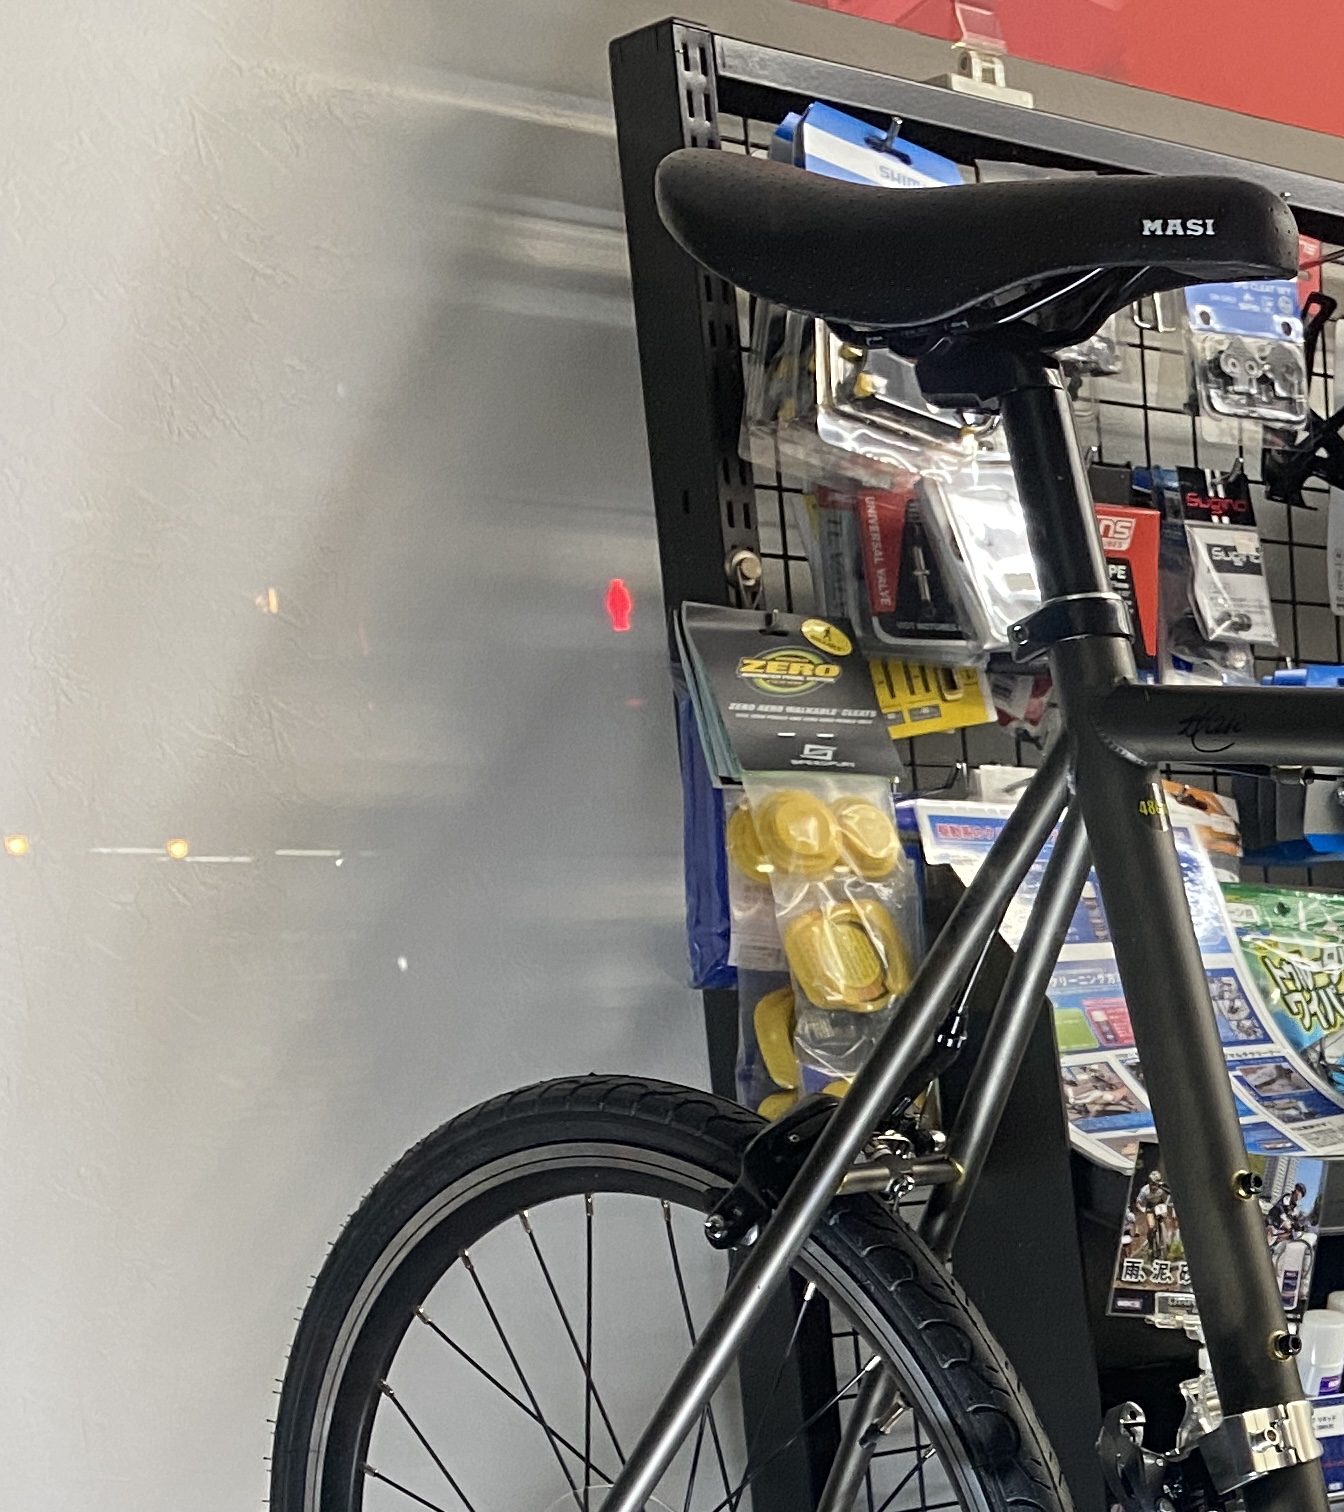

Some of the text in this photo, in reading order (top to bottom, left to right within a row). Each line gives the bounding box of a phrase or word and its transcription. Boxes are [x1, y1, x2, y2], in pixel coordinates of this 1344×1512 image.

[879, 165, 928, 188] SHIM
[1142, 219, 1216, 236] MASI
[864, 495, 892, 606] UNIVERSAL VALVE
[739, 657, 843, 678] ZERO
[785, 706, 838, 717] WALKABLE
[840, 708, 877, 718] CLEATS
